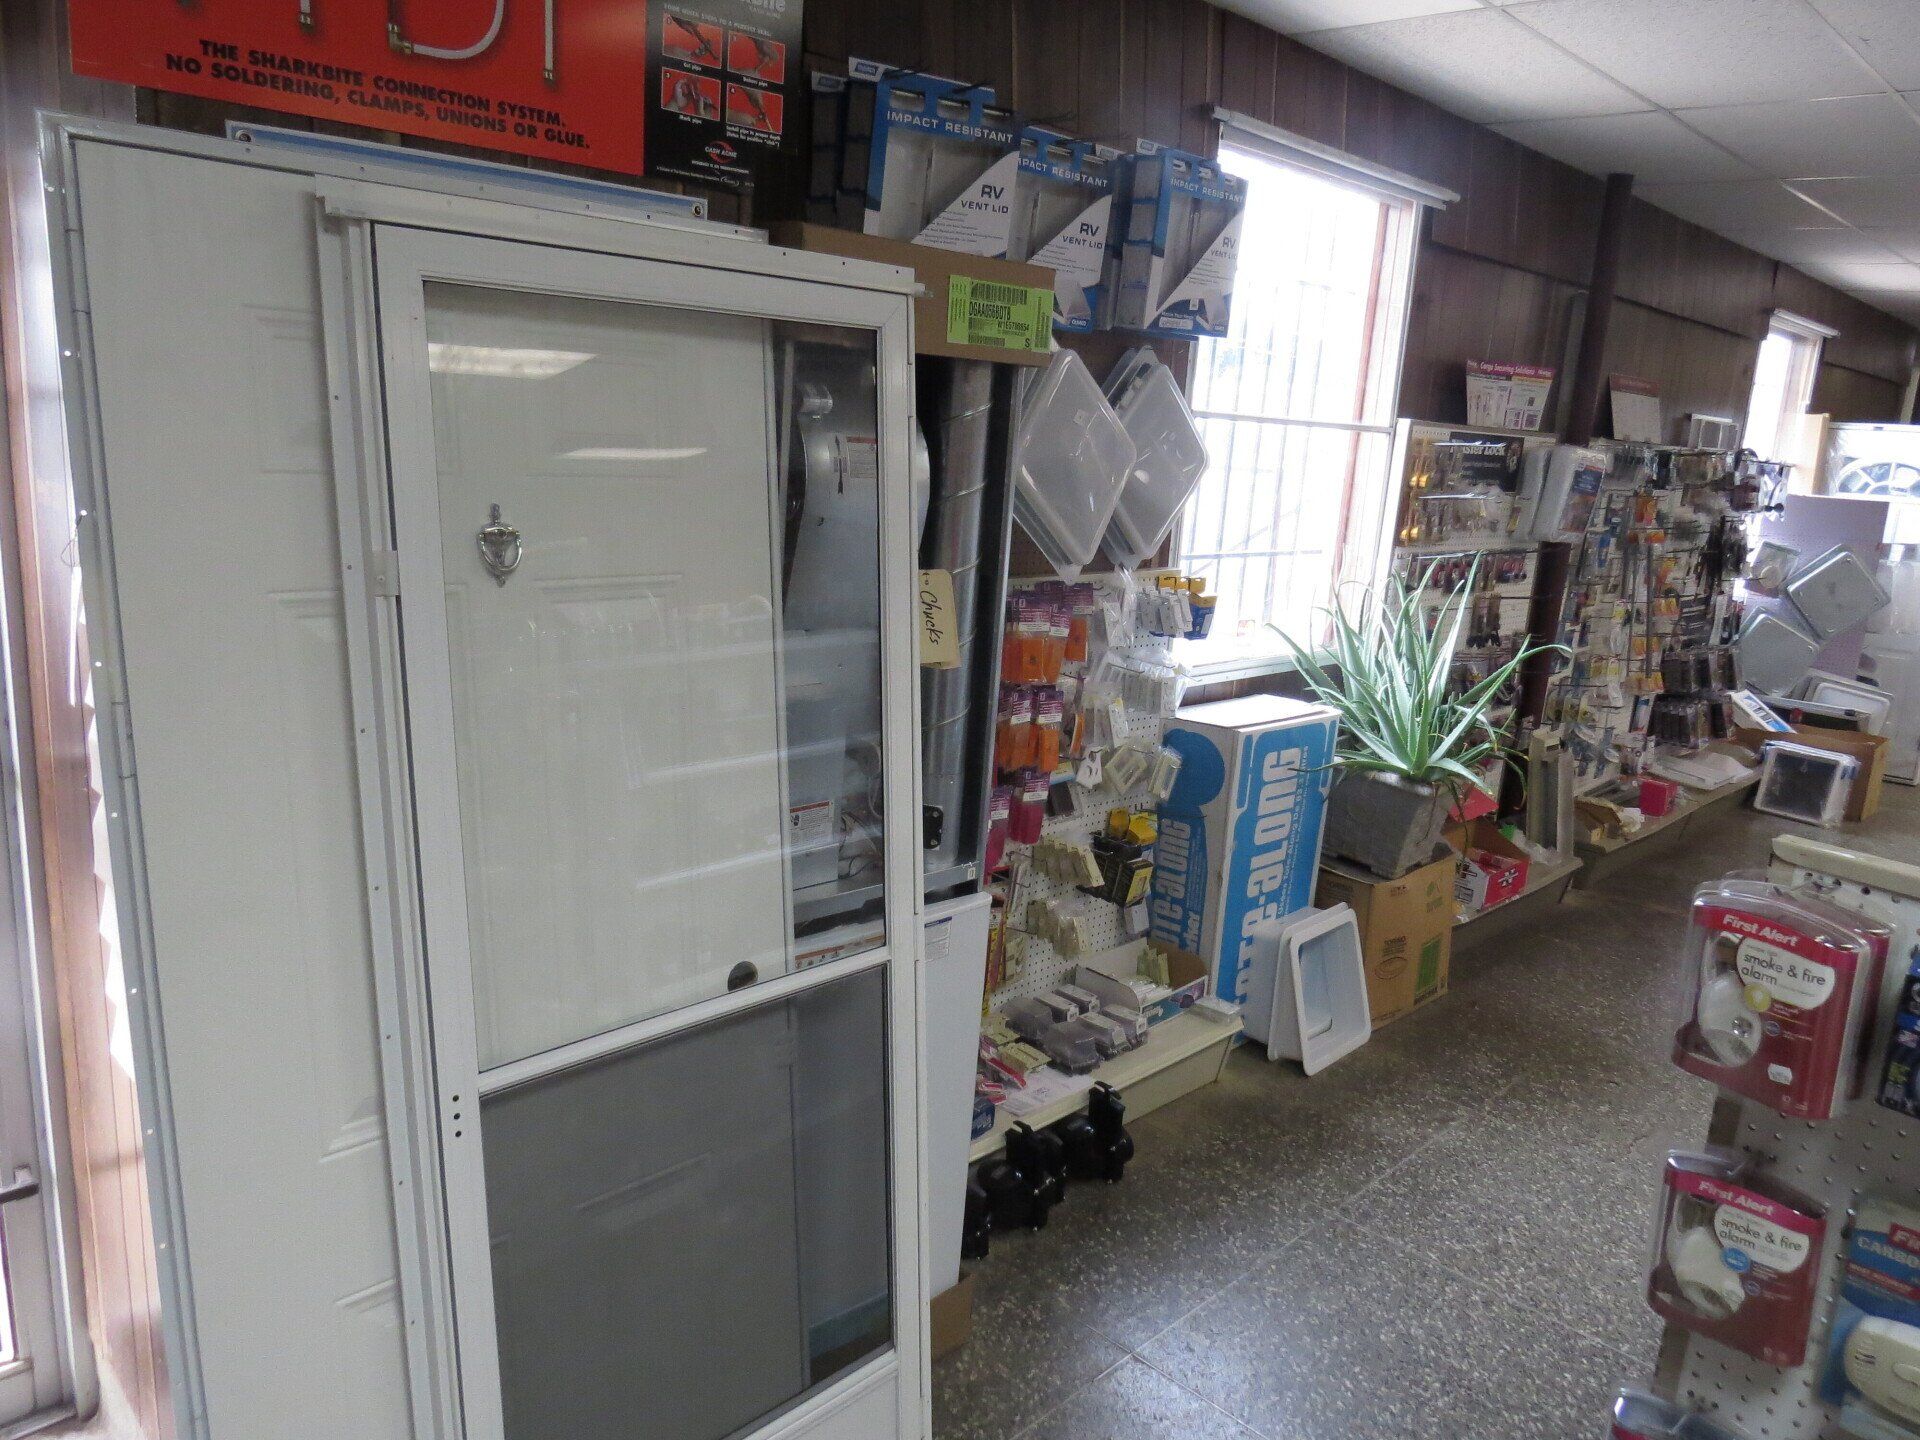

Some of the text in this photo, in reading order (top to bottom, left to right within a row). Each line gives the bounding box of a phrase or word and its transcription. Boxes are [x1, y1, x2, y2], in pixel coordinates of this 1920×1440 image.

[200, 39, 567, 128] THE SHARKBITE CONNECTION SYSTEM.
[166, 53, 591, 149] NO SOLDERING, CLAMPS, UNIONS OR GLUE.
[887, 110, 1014, 144] IMPACT RESISTANT
[1052, 166, 1108, 188] RESISTANT
[1170, 178, 1199, 191] IMPACT
[981, 184, 1005, 199] RV
[961, 200, 1009, 214] VENT LID
[1079, 222, 1101, 237] RV
[1062, 235, 1103, 250] VENT LID
[1222, 236, 1236, 249] RV
[1211, 249, 1230, 260] VENT
[1723, 914, 1799, 947] First Alert
[1741, 967, 1777, 986] alarm
[1743, 953, 1826, 986] smoke & fire
[1699, 1181, 1774, 1215] First Alert
[1719, 1230, 1756, 1249] alarm
[1721, 1218, 1802, 1252] smoke & fire
